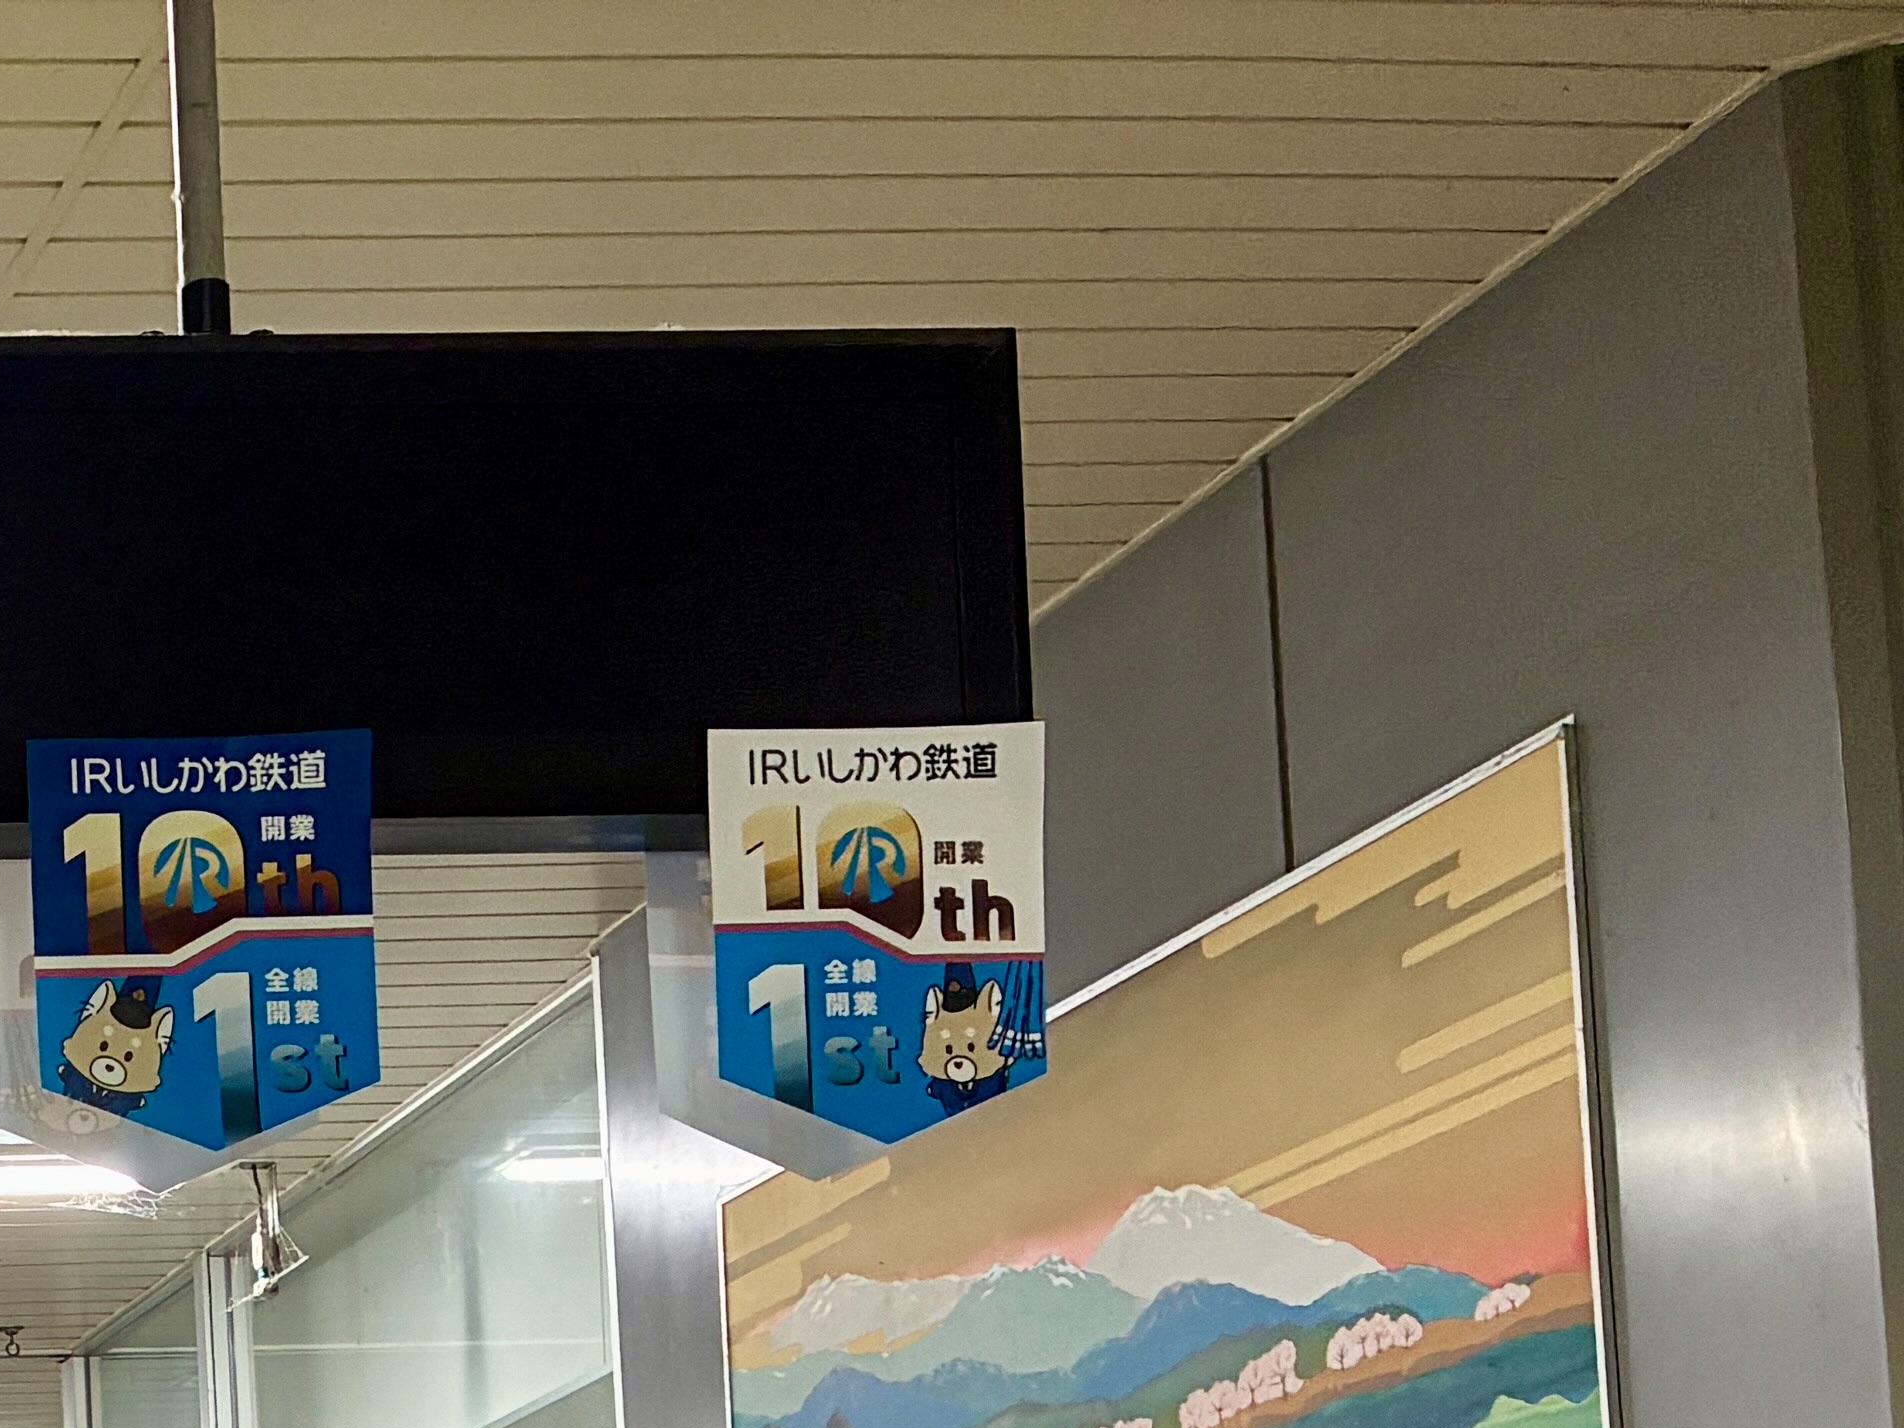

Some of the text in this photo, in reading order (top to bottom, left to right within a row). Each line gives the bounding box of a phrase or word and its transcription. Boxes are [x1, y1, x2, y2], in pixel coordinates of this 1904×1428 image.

[72, 751, 327, 795] IRいしかわ鉄道
[751, 742, 999, 787] IRいしかわ鉄道
